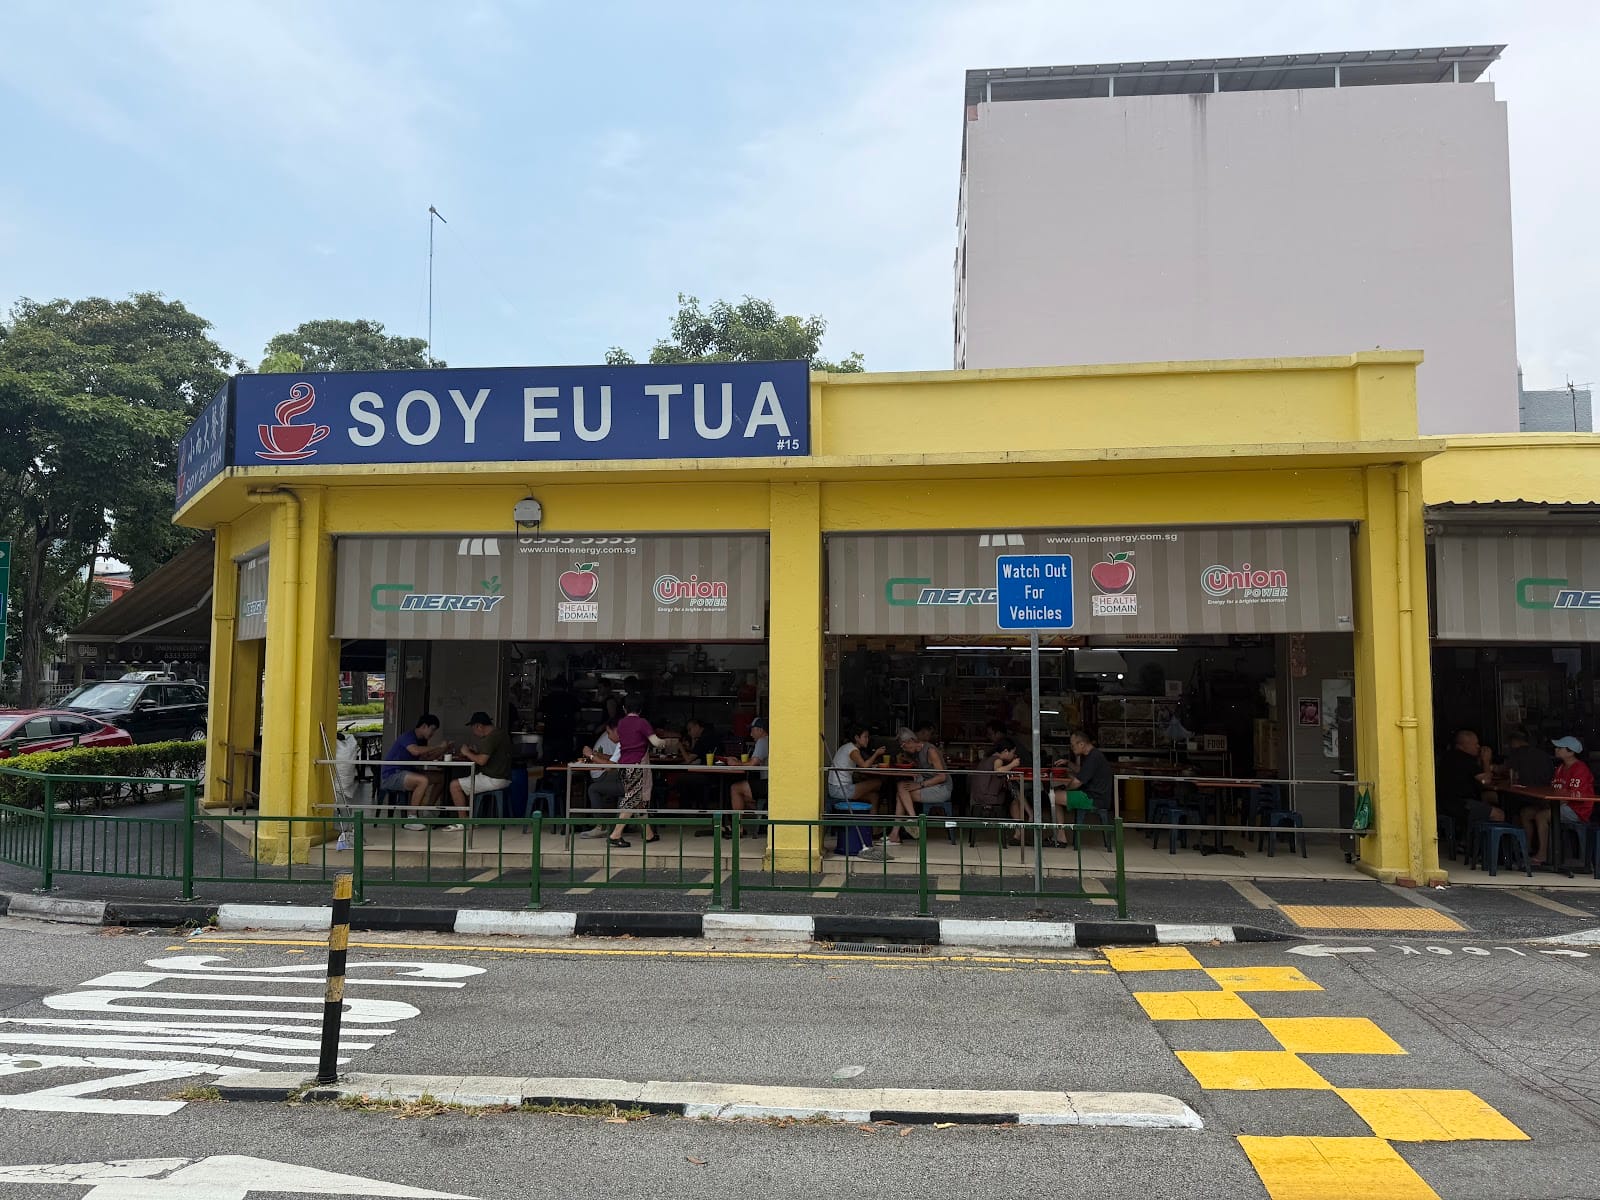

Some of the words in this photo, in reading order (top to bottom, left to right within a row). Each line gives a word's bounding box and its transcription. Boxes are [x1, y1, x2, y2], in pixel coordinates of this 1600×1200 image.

[347, 388, 491, 447] SOY
[523, 384, 612, 442] EU
[643, 381, 792, 440] TUA
[776, 439, 800, 450] #15
[1046, 533, 1178, 544] www.unionenergy.com.sg
[519, 545, 637, 555] www.unionenergy.com.sg
[1002, 563, 1040, 578] Watch
[1045, 563, 1068, 578] Out
[1024, 585, 1045, 599] For
[1243, 588, 1289, 598] POWER
[690, 598, 728, 607] POWER
[1099, 597, 1137, 605] HEALTH
[564, 604, 598, 612] HEALTH
[1009, 605, 1063, 620] Vehicles
[1099, 604, 1137, 613] DOMAIN
[564, 612, 598, 620] DOMAIN
[1569, 777, 1581, 788] 23
[1389, 943, 1527, 957] LOOK
